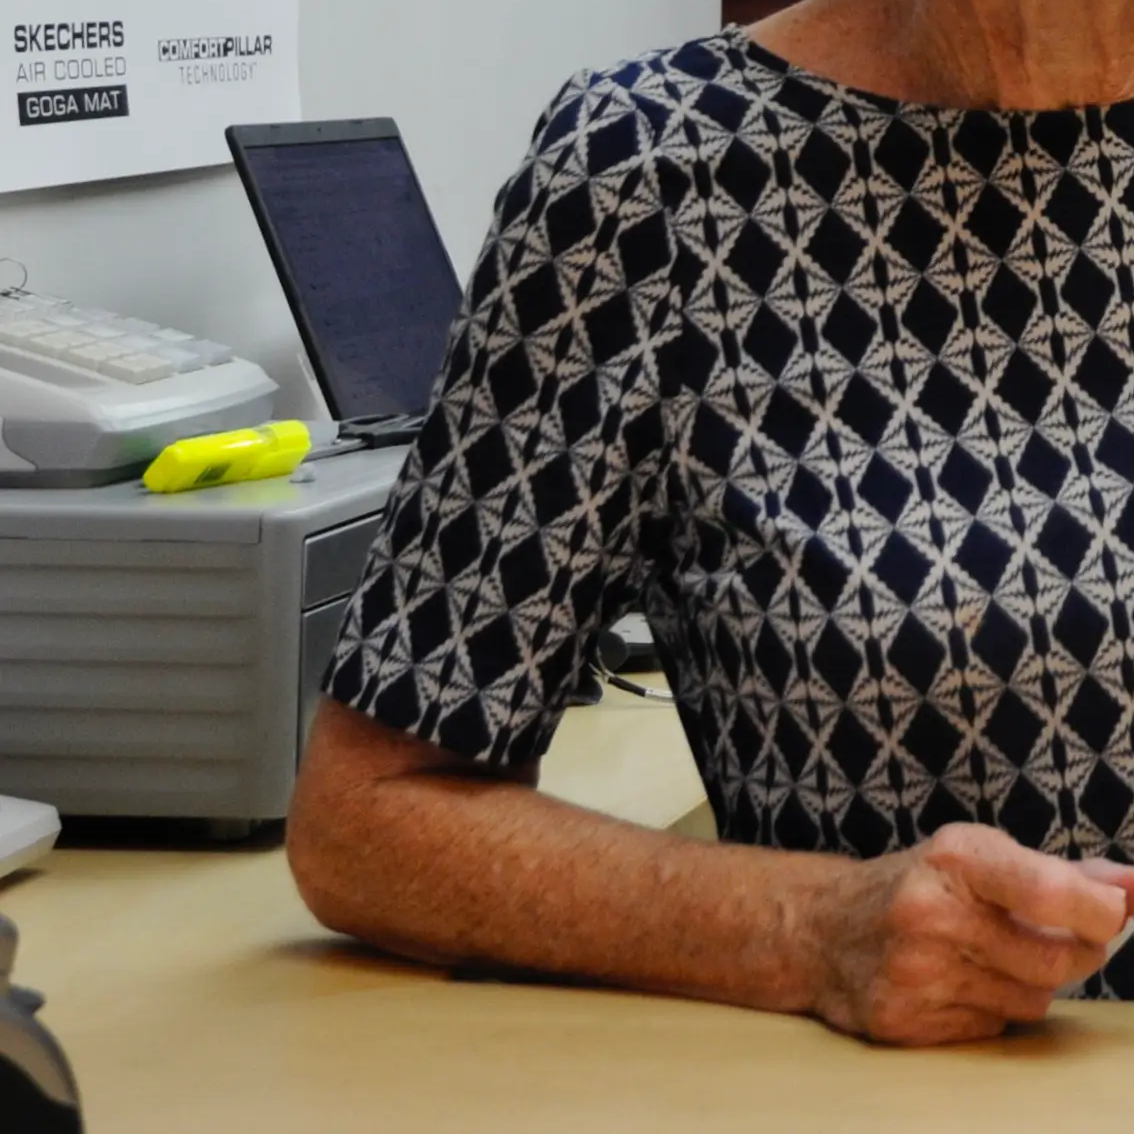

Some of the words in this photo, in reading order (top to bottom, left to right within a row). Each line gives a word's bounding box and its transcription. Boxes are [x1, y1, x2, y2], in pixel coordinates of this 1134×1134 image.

[14, 21, 125, 53] SKECHERS
[158, 34, 272, 62] COMFORTPILLAR
[16, 61, 47, 83] AIR
[54, 56, 127, 82] COOLED
[179, 62, 257, 85] TECHNOLOGY
[26, 94, 79, 119] GOGA
[84, 90, 122, 112] MAT
